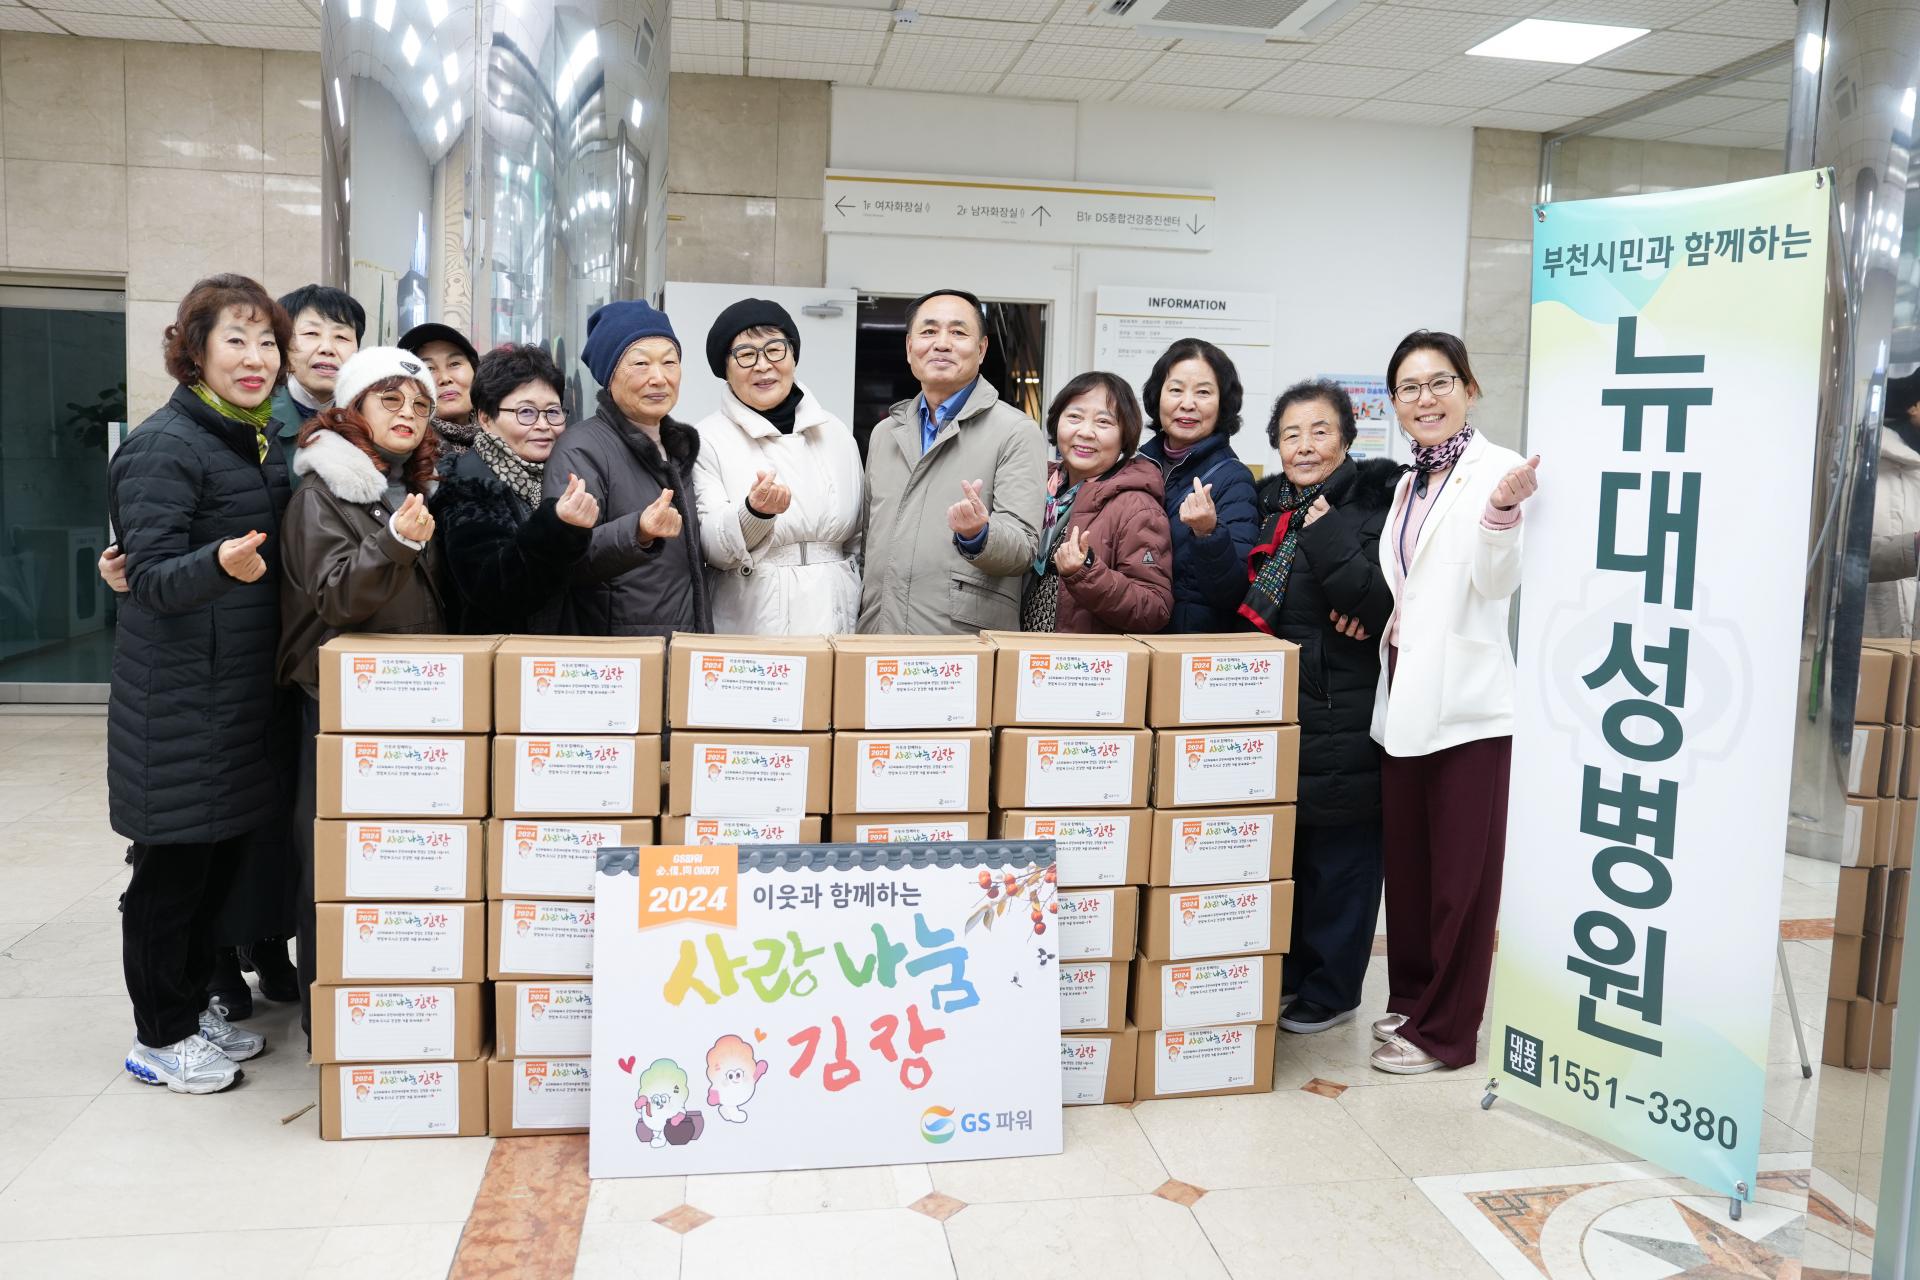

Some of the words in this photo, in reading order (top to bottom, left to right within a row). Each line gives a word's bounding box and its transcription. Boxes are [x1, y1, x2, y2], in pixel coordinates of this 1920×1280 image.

[875, 200, 923, 213] 여자화장실
[971, 206, 1018, 218] 남자화장실
[1542, 235, 1675, 278] 부천시민과
[1685, 224, 1812, 267] 함께하는
[1148, 296, 1226, 311] INFORMATION
[421, 661, 447, 677] 김장
[599, 665, 624, 681] 김장
[766, 662, 790, 678] 김장
[939, 662, 962, 677] 김장
[1090, 658, 1112, 673] 김장
[1249, 658, 1270, 673] 김장
[1566, 316, 1713, 1057] 뉴대성병원
[1098, 742, 1120, 757] 김장
[1242, 738, 1263, 753] 김장
[423, 747, 448, 762] 김장
[594, 746, 619, 761] 김장
[769, 753, 793, 768] 김장
[931, 746, 954, 761] 김장
[760, 825, 784, 840] 김장
[1094, 823, 1115, 838] 김장
[1238, 821, 1259, 836] 김장
[426, 831, 451, 847] 김장
[581, 831, 605, 846] 김장
[648, 886, 728, 912] 2024
[753, 883, 823, 910] 이웃과
[830, 881, 922, 909] 함께하는
[1236, 892, 1258, 907] 김장
[1077, 897, 1100, 912] 김장
[423, 912, 448, 928] 김장
[663, 931, 825, 1007] 사랑
[834, 913, 981, 1013] 나눔
[1074, 969, 1095, 983] 김장
[1228, 964, 1249, 978] 김장
[414, 994, 439, 1009] 김장
[1221, 1029, 1242, 1044] 김장
[788, 1005, 946, 1092] 김장
[1075, 1044, 1096, 1058] 김장
[1510, 1033, 1536, 1059] 대표
[1510, 1050, 1536, 1077] 번호
[418, 1070, 442, 1085] 김장
[1549, 1054, 1738, 1150] 1551-3380
[961, 1113, 990, 1133] GS
[996, 1110, 1033, 1131] 파워
